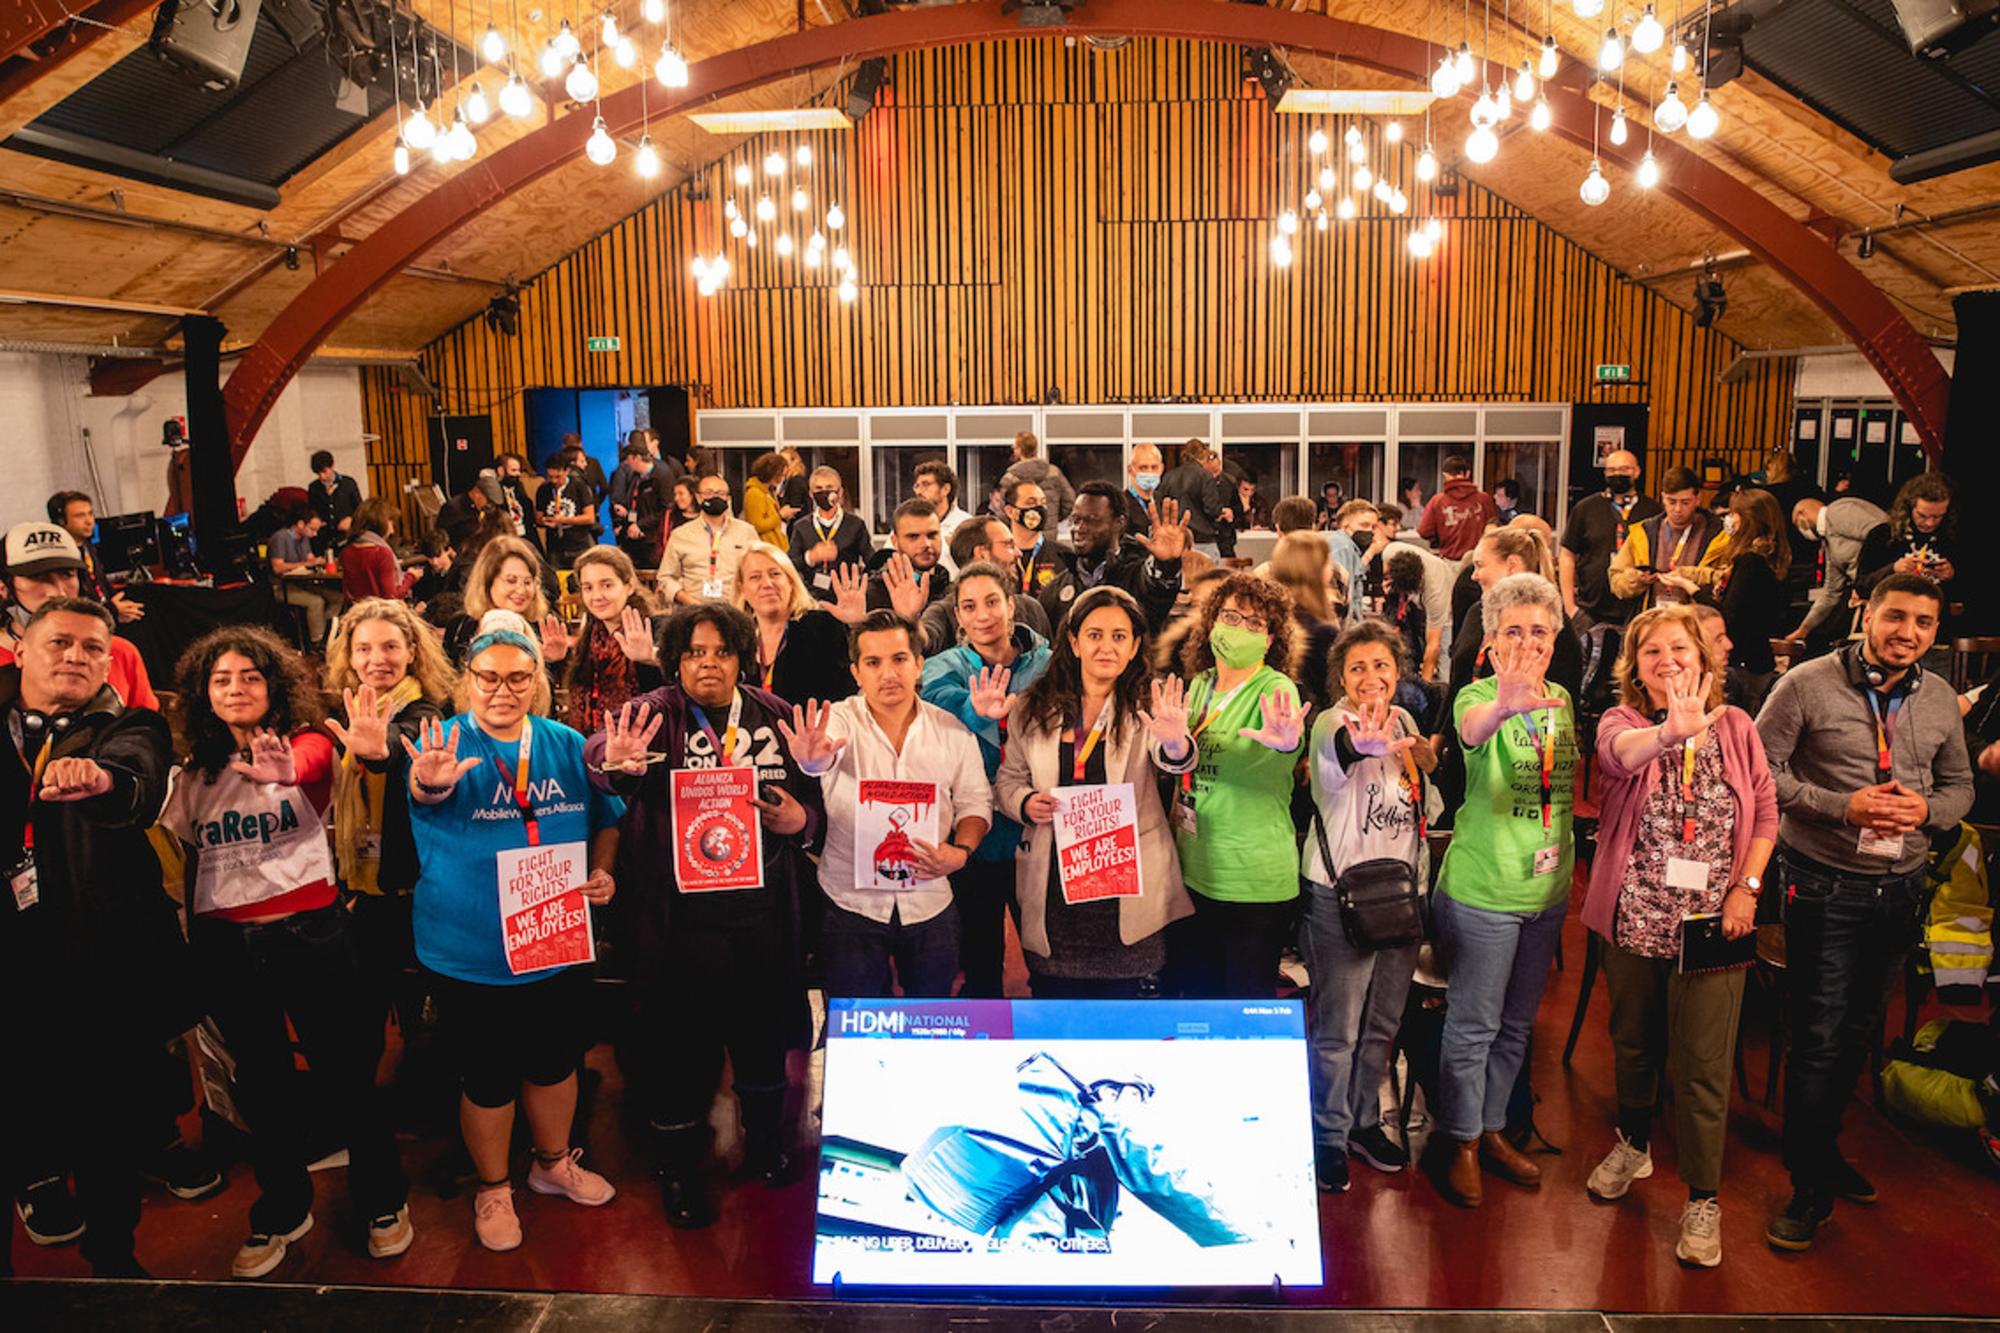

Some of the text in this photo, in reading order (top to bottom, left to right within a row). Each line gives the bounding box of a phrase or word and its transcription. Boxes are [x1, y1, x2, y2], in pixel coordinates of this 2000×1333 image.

[23, 531, 62, 547] ATR
[681, 784, 749, 798] UNIDOS WORLD
[694, 773, 734, 785] ALIANZA
[698, 798, 732, 810] ACTION
[1071, 788, 1103, 810] FIGHT
[1063, 799, 1122, 829] FOR YOUR
[1074, 815, 1120, 839] RIGHTS!
[1070, 835, 1118, 862] WE ARE
[518, 849, 554, 874] FIGHT
[1064, 846, 1137, 882] EMPLOYEES!
[510, 860, 573, 895] FOR YOUR
[521, 878, 569, 906] RIGHTS!
[515, 899, 566, 929] WE ARE
[508, 909, 586, 951] EMPLOYEES!
[841, 1010, 904, 1033] HDMI
